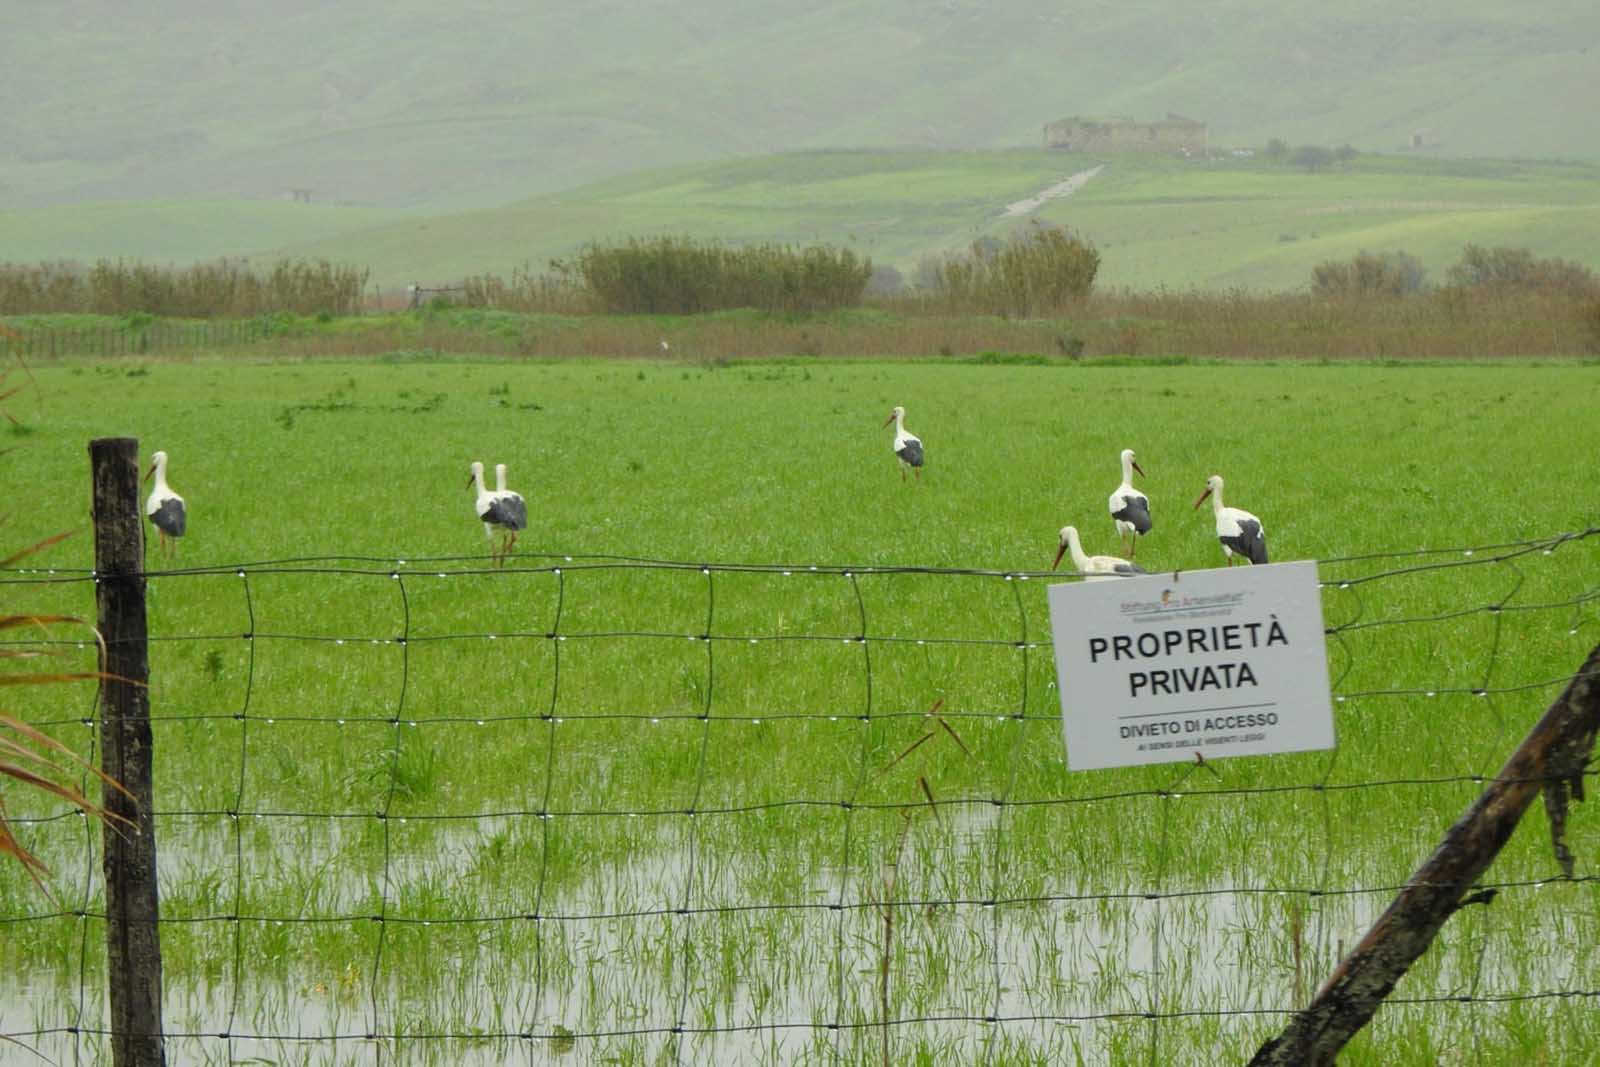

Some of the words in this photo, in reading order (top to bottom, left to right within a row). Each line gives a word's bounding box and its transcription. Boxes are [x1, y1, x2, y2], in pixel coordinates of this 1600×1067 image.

[1088, 614, 1289, 663] PROPRIETÀ
[1128, 662, 1258, 697] PRIVATA
[1119, 721, 1181, 739] DIVIETO
[1185, 720, 1200, 733] DI
[1204, 712, 1279, 731] ACCESSO
[1175, 738, 1202, 748] DELLE
